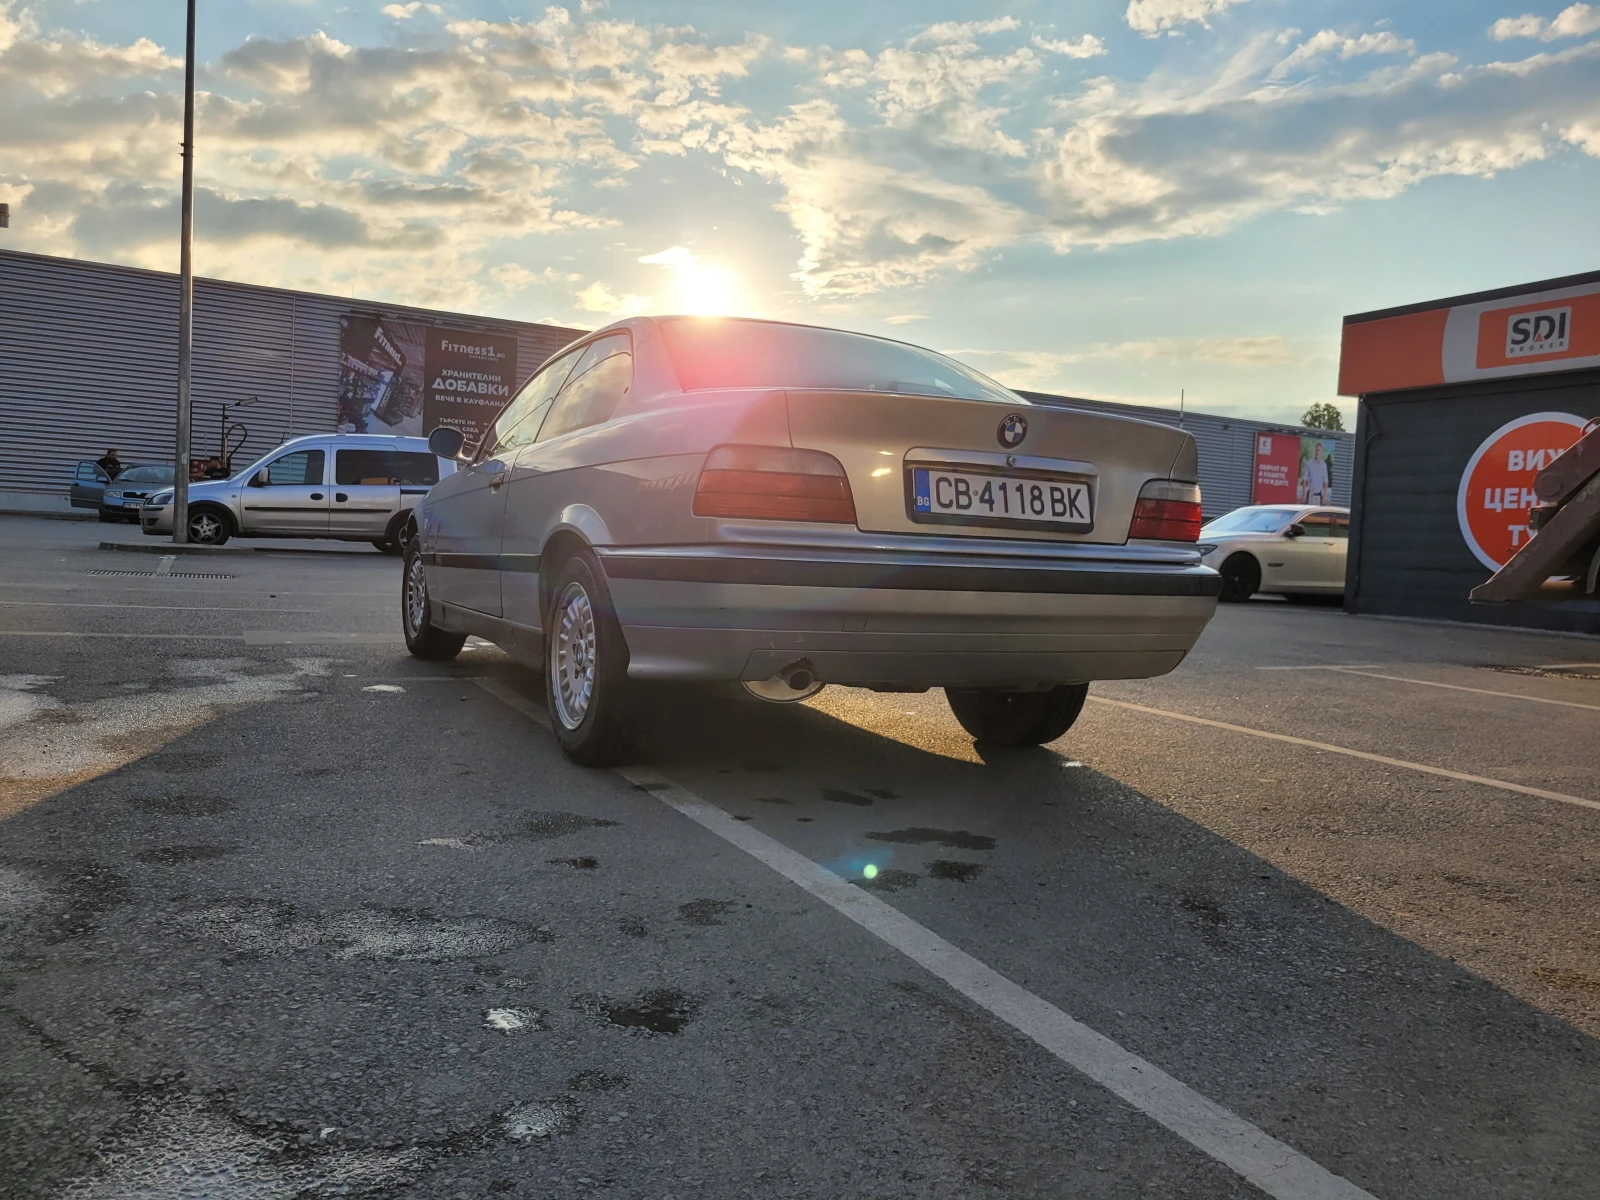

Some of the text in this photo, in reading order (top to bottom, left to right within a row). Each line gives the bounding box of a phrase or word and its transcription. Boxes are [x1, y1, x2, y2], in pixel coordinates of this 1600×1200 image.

[1511, 312, 1566, 345] SDI
[1510, 341, 1564, 354] BROKER
[442, 369, 501, 383] ХРАНИТЕЛНИ
[432, 378, 509, 396] ДОБАВКИ
[435, 394, 455, 402] ВЕЧЕ
[439, 417, 466, 425] ТЪРСЕТЕ
[917, 496, 930, 506] BG
[1484, 488, 1548, 513] ЦЕН
